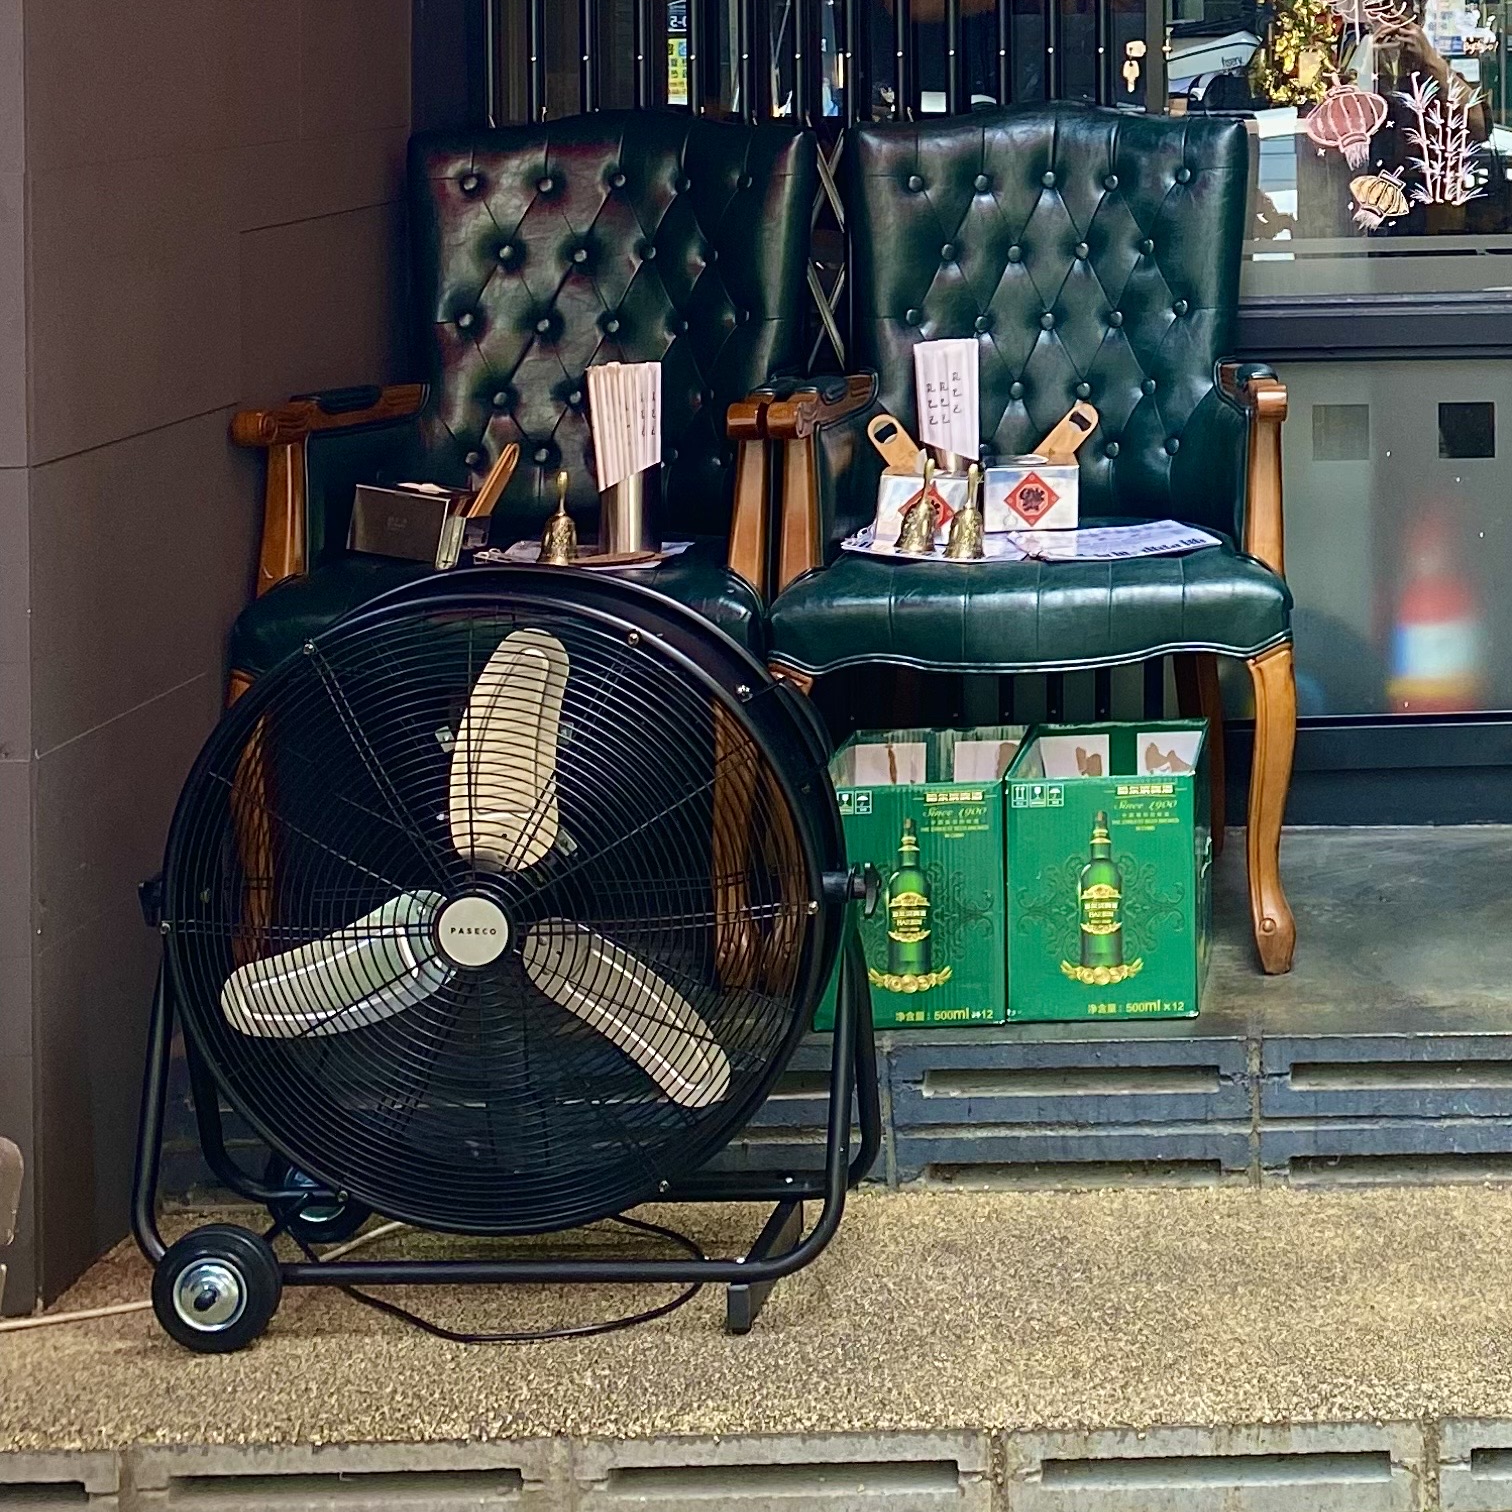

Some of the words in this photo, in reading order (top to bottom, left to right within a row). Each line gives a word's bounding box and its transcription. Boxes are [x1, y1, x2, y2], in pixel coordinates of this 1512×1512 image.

[450, 927, 497, 935] PASECO
[1125, 999, 1161, 1012] 500ml
[933, 1007, 970, 1020] 500ml
